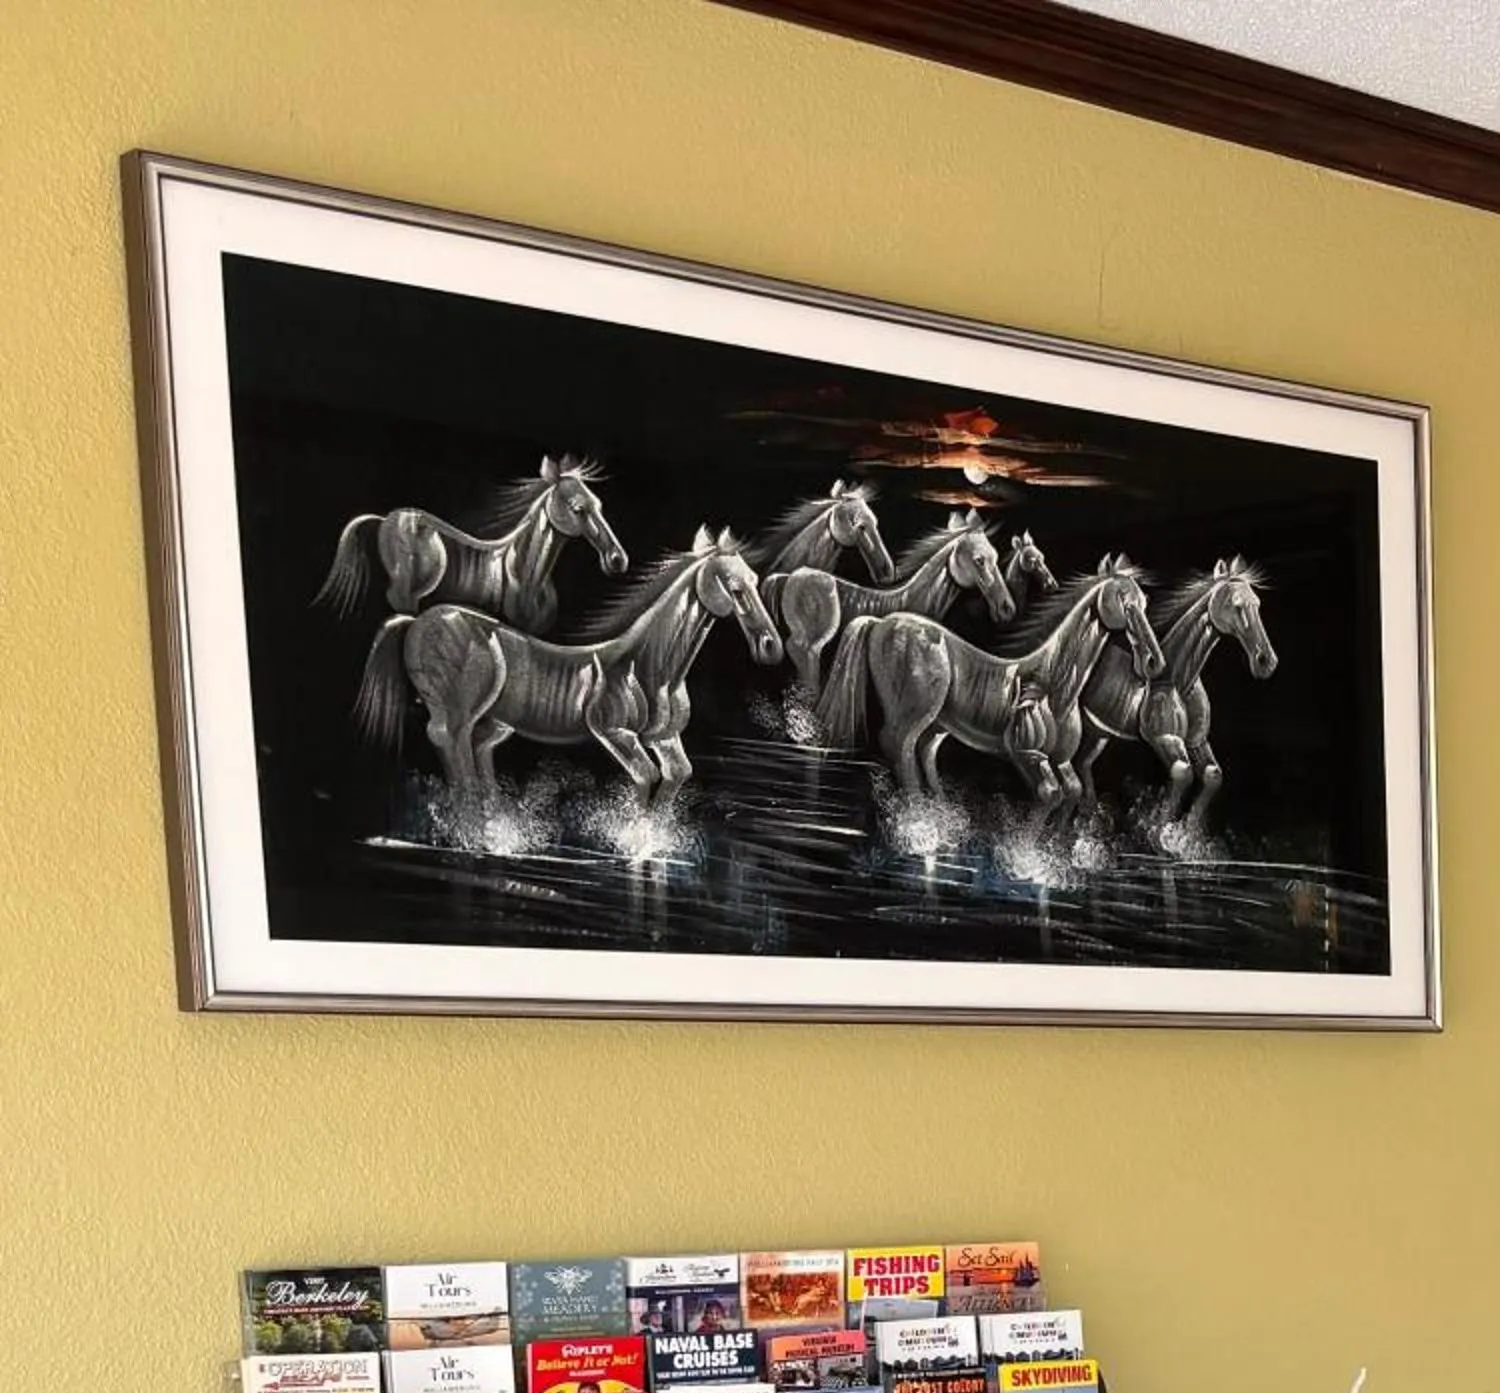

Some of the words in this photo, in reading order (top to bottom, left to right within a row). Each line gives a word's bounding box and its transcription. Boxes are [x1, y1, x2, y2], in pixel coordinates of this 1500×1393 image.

[853, 1254, 940, 1277] FISHING
[436, 1272, 457, 1286] Air
[864, 1274, 931, 1298] TRIPS
[266, 1280, 369, 1311] Berkeley
[427, 1284, 472, 1298] Tours
[655, 1335, 710, 1355] NAVAL
[713, 1332, 755, 1351] BASE
[268, 1359, 368, 1377] OPERATION
[438, 1356, 459, 1369] Air
[536, 1357, 581, 1372] Believe
[673, 1350, 739, 1370] CRUISES
[431, 1367, 475, 1383] Tours
[1011, 1364, 1093, 1388] SKYDIVING
